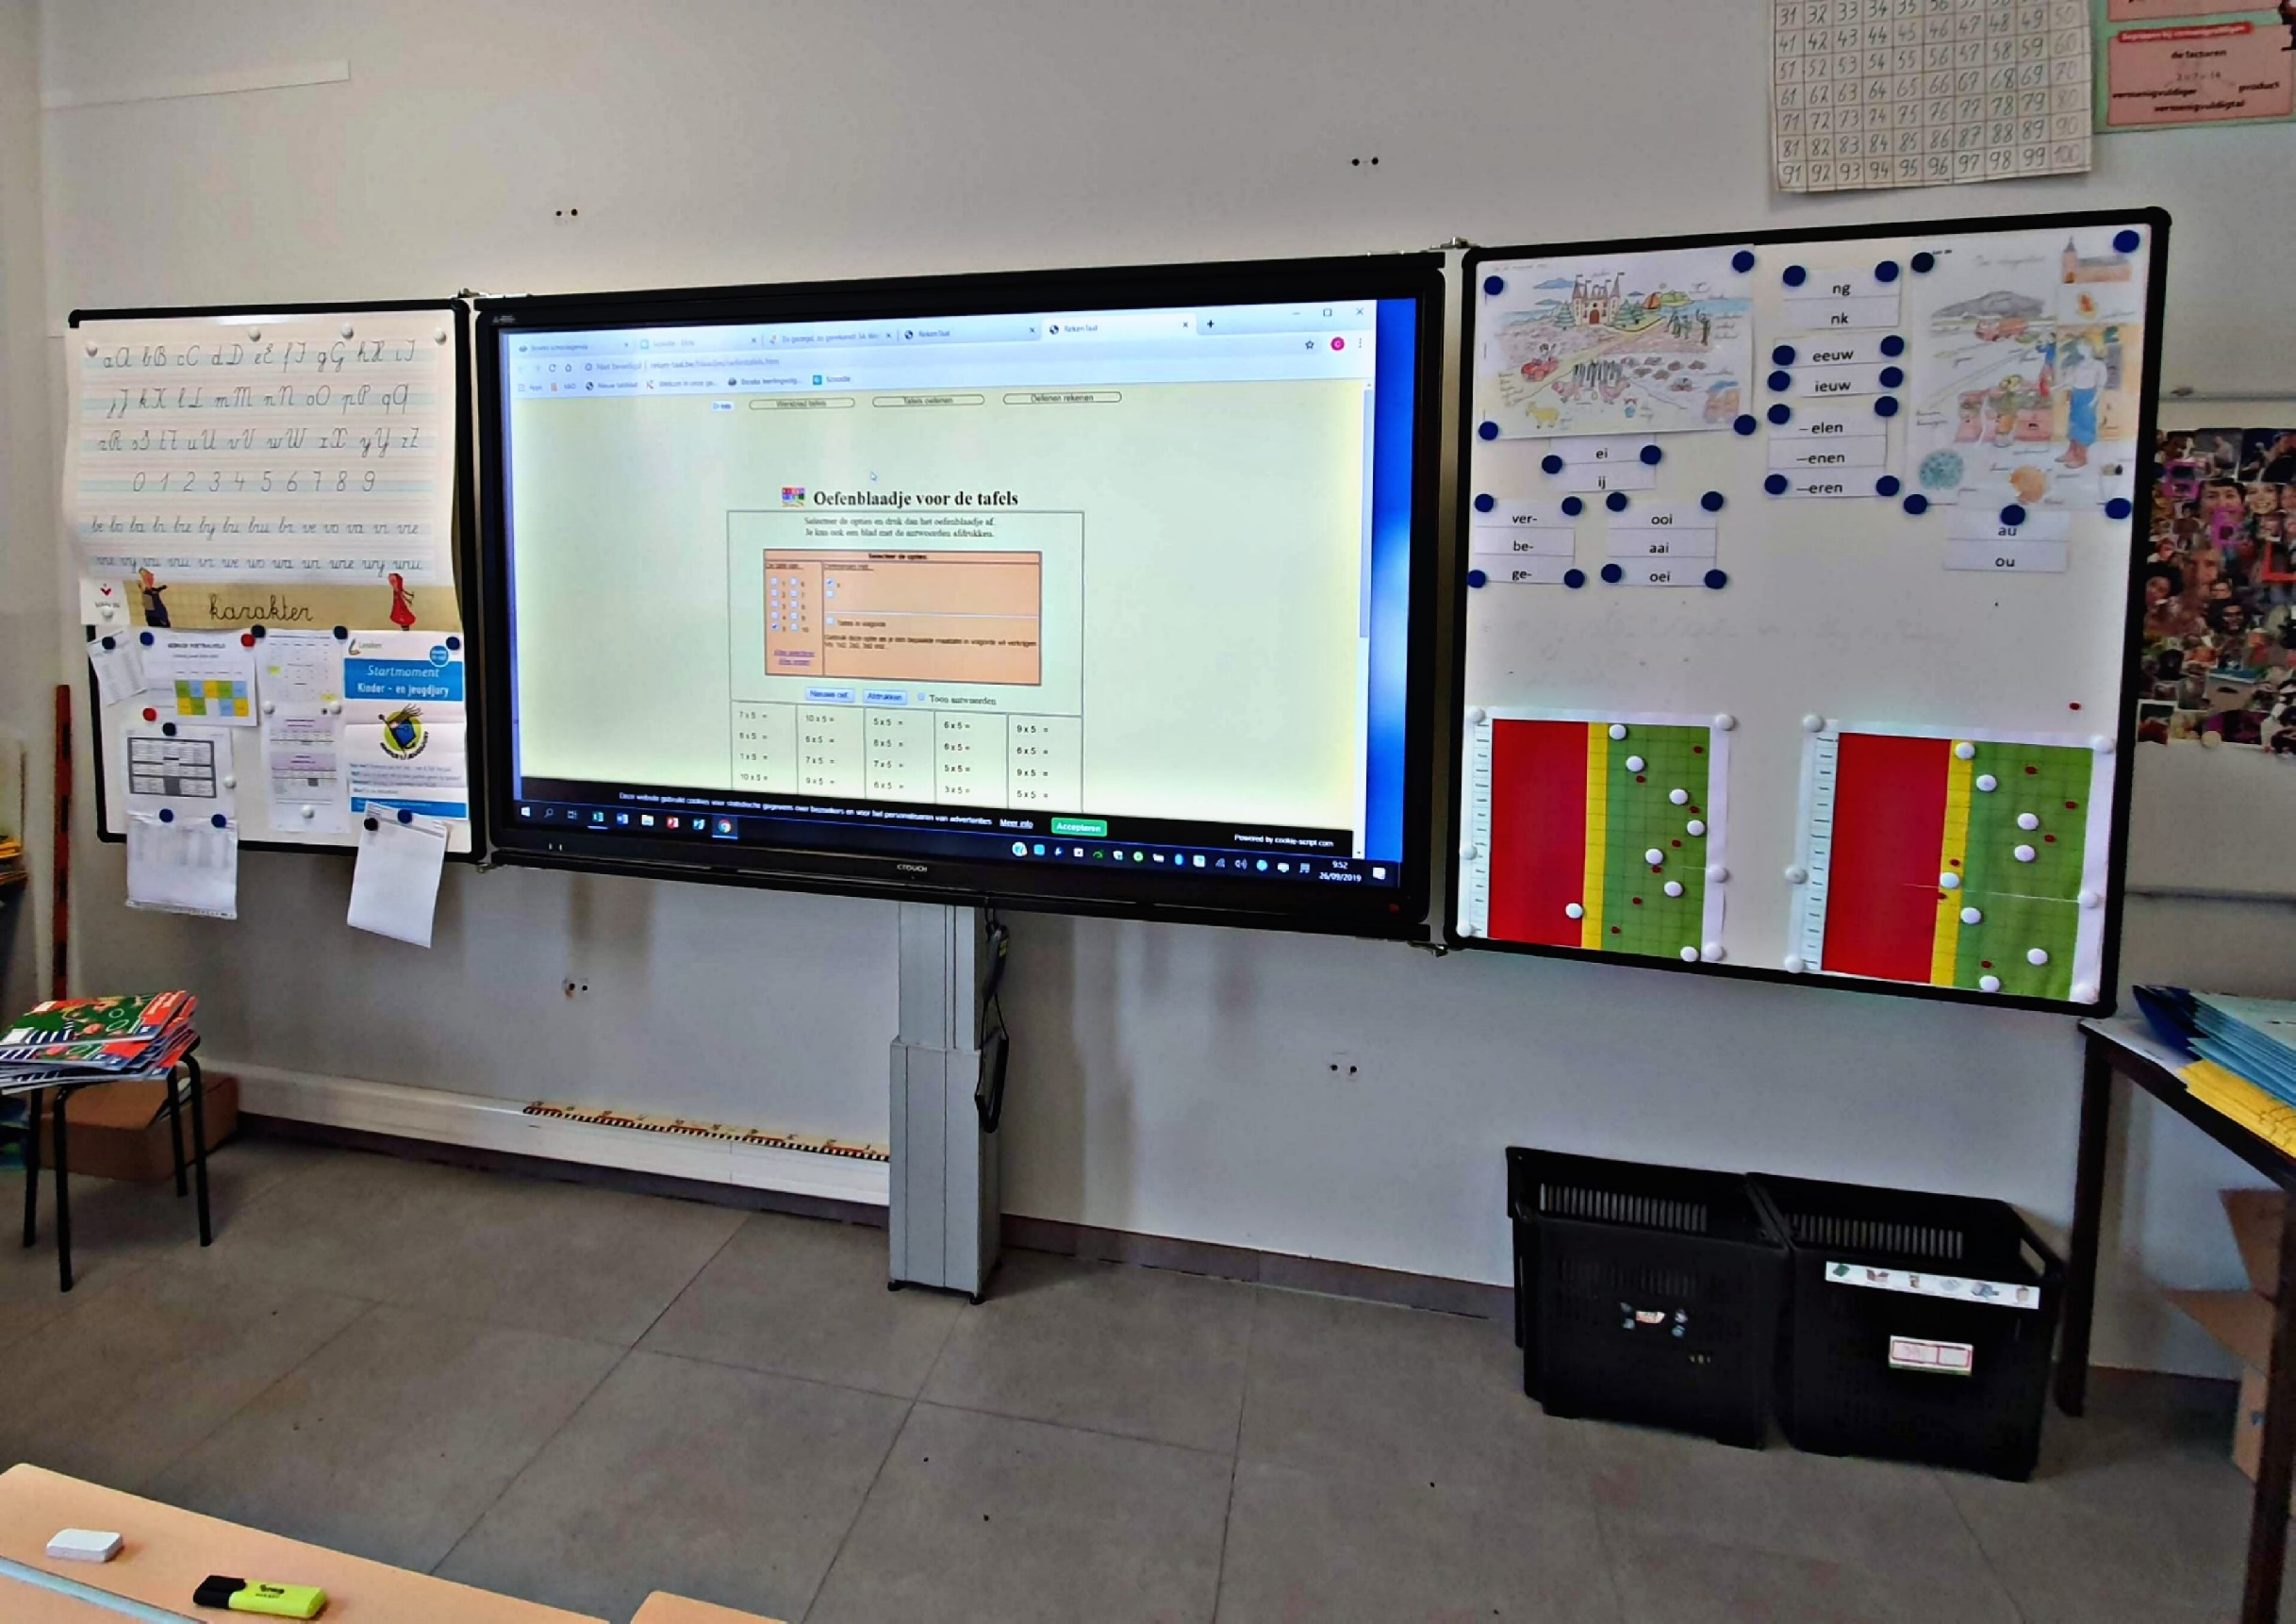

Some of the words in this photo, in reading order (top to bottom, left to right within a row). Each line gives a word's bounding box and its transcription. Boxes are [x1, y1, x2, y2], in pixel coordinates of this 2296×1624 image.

[1780, 8, 1796, 25] 31
[1809, 7, 1826, 23] 32
[1839, 2, 1858, 20] 33
[1869, 1, 1887, 17] 34
[2238, 81, 2279, 92] product
[1783, 113, 1799, 130] 71
[1812, 112, 1830, 128] 72
[1840, 110, 1858, 126] 73
[1870, 109, 1885, 124] 74
[1898, 105, 1917, 124] 75
[1930, 102, 1949, 120] 76
[1959, 98, 1982, 116] 77
[1990, 95, 2013, 114] 78
[2023, 93, 2044, 111] 79
[1783, 167, 1801, 183] 91
[1812, 165, 1830, 181] 92
[1840, 164, 1859, 180] 93
[1870, 162, 1889, 179] 94
[1901, 160, 1917, 176] 95
[1929, 158, 1948, 175] 96
[1958, 155, 1979, 173] 97
[1990, 152, 2010, 170] 98
[2023, 148, 2045, 167] 99
[2055, 144, 2078, 163] 100
[1833, 284, 1850, 297] ng
[1830, 311, 1849, 324] nk
[1812, 349, 1854, 362] eeuw
[1814, 378, 1852, 392] ieuw
[1595, 447, 1608, 459] ei
[134, 472, 145, 491] 0
[160, 472, 168, 491] 1
[183, 472, 195, 491] 2
[209, 472, 220, 491] 3
[235, 472, 245, 491] 4
[261, 472, 272, 491] 5
[288, 472, 298, 491] 6
[313, 472, 322, 491] 7
[337, 472, 347, 491] 8
[364, 472, 375, 491] 9
[1597, 475, 1608, 490] ij
[814, 491, 912, 509] Oefenblaadje
[916, 492, 951, 505] voor
[954, 491, 974, 505] de
[978, 491, 1018, 505] tafels
[934, 518, 983, 527] oefenblaadje
[1511, 513, 1537, 524] ver-
[1651, 513, 1673, 525] ooi
[1998, 525, 2017, 537] au
[1512, 539, 1533, 553] be-
[1649, 542, 1669, 554] aai
[1995, 555, 2015, 568] ou
[1511, 568, 1532, 583] ge-
[1650, 571, 1670, 583] oei
[209, 593, 313, 621] karakter
[367, 665, 439, 677] Startmoment
[357, 684, 384, 692] Kinder
[396, 686, 405, 694] en
[408, 685, 448, 697] jeugdjury
[930, 695, 949, 704] Toon
[1056, 822, 1100, 833] Accepteren
[1235, 835, 1263, 843] Powered
[1265, 837, 1273, 845] by
[1332, 860, 1347, 870] 9:52
[1319, 872, 1362, 882] 26/09/2019
